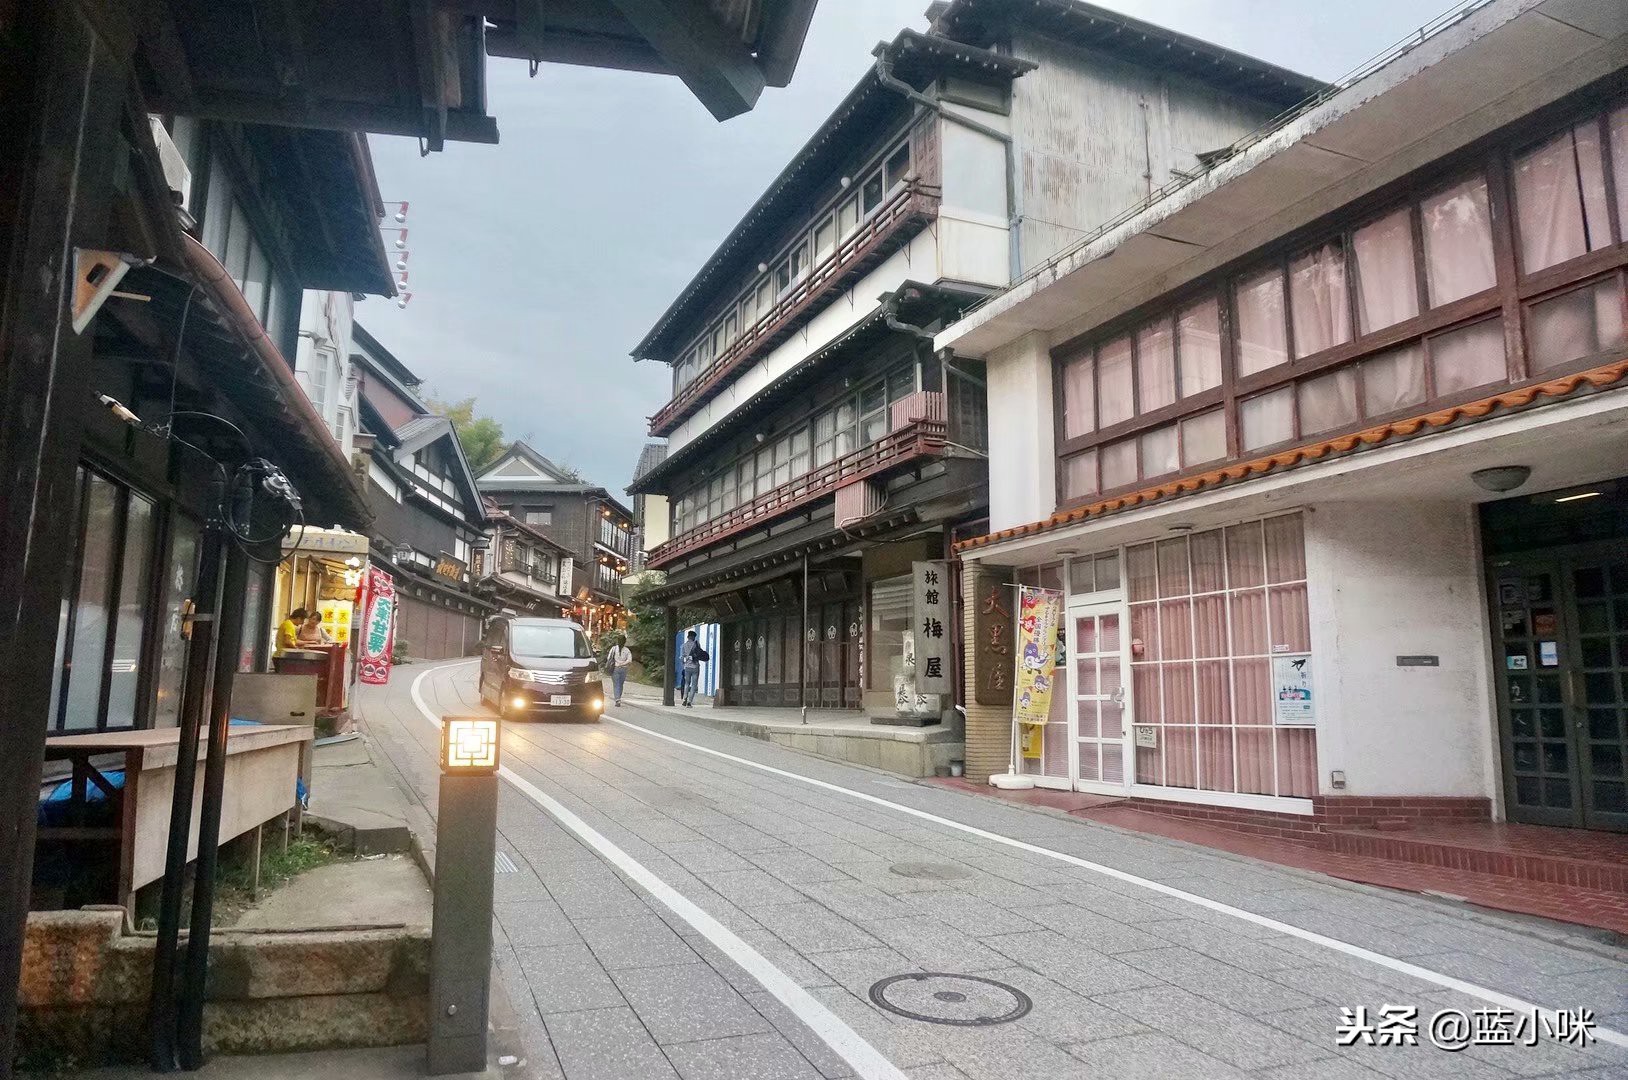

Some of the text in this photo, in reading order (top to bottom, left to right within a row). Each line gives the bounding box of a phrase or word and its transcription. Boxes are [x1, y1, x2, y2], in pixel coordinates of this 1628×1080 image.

[367, 597, 391, 655] 天津甘栗
[923, 570, 943, 679] 旅館梅屋
